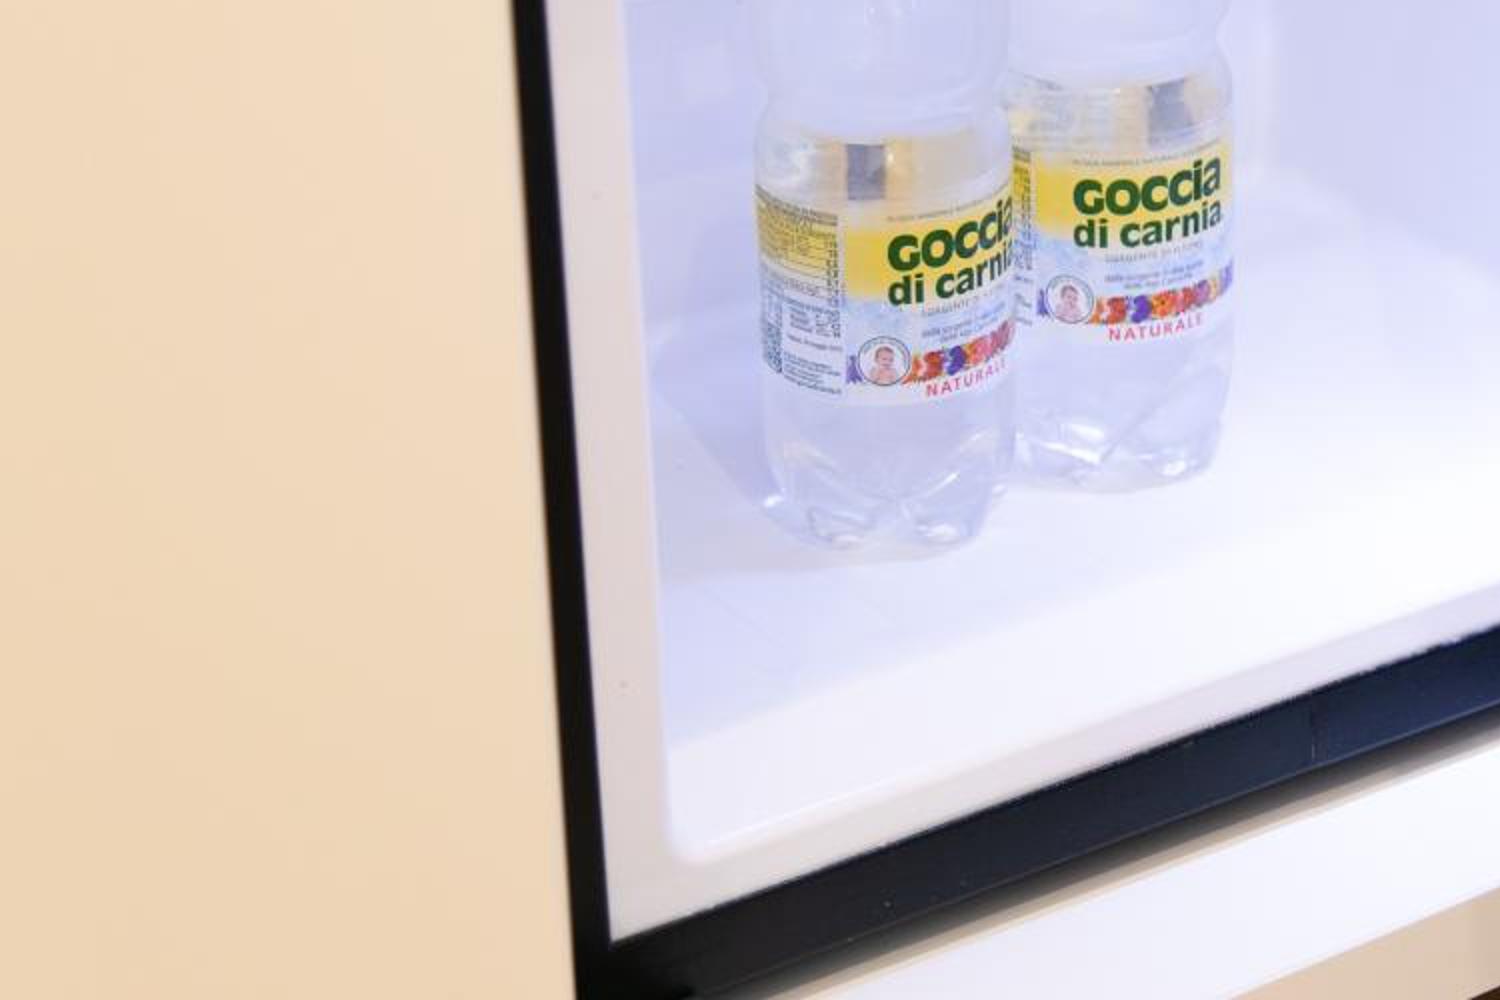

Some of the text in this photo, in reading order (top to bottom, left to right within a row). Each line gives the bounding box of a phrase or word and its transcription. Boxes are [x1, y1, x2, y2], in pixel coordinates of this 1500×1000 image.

[1073, 199, 1222, 248] di carnia
[888, 273, 925, 305] di
[1108, 312, 1204, 342] NATURALE
